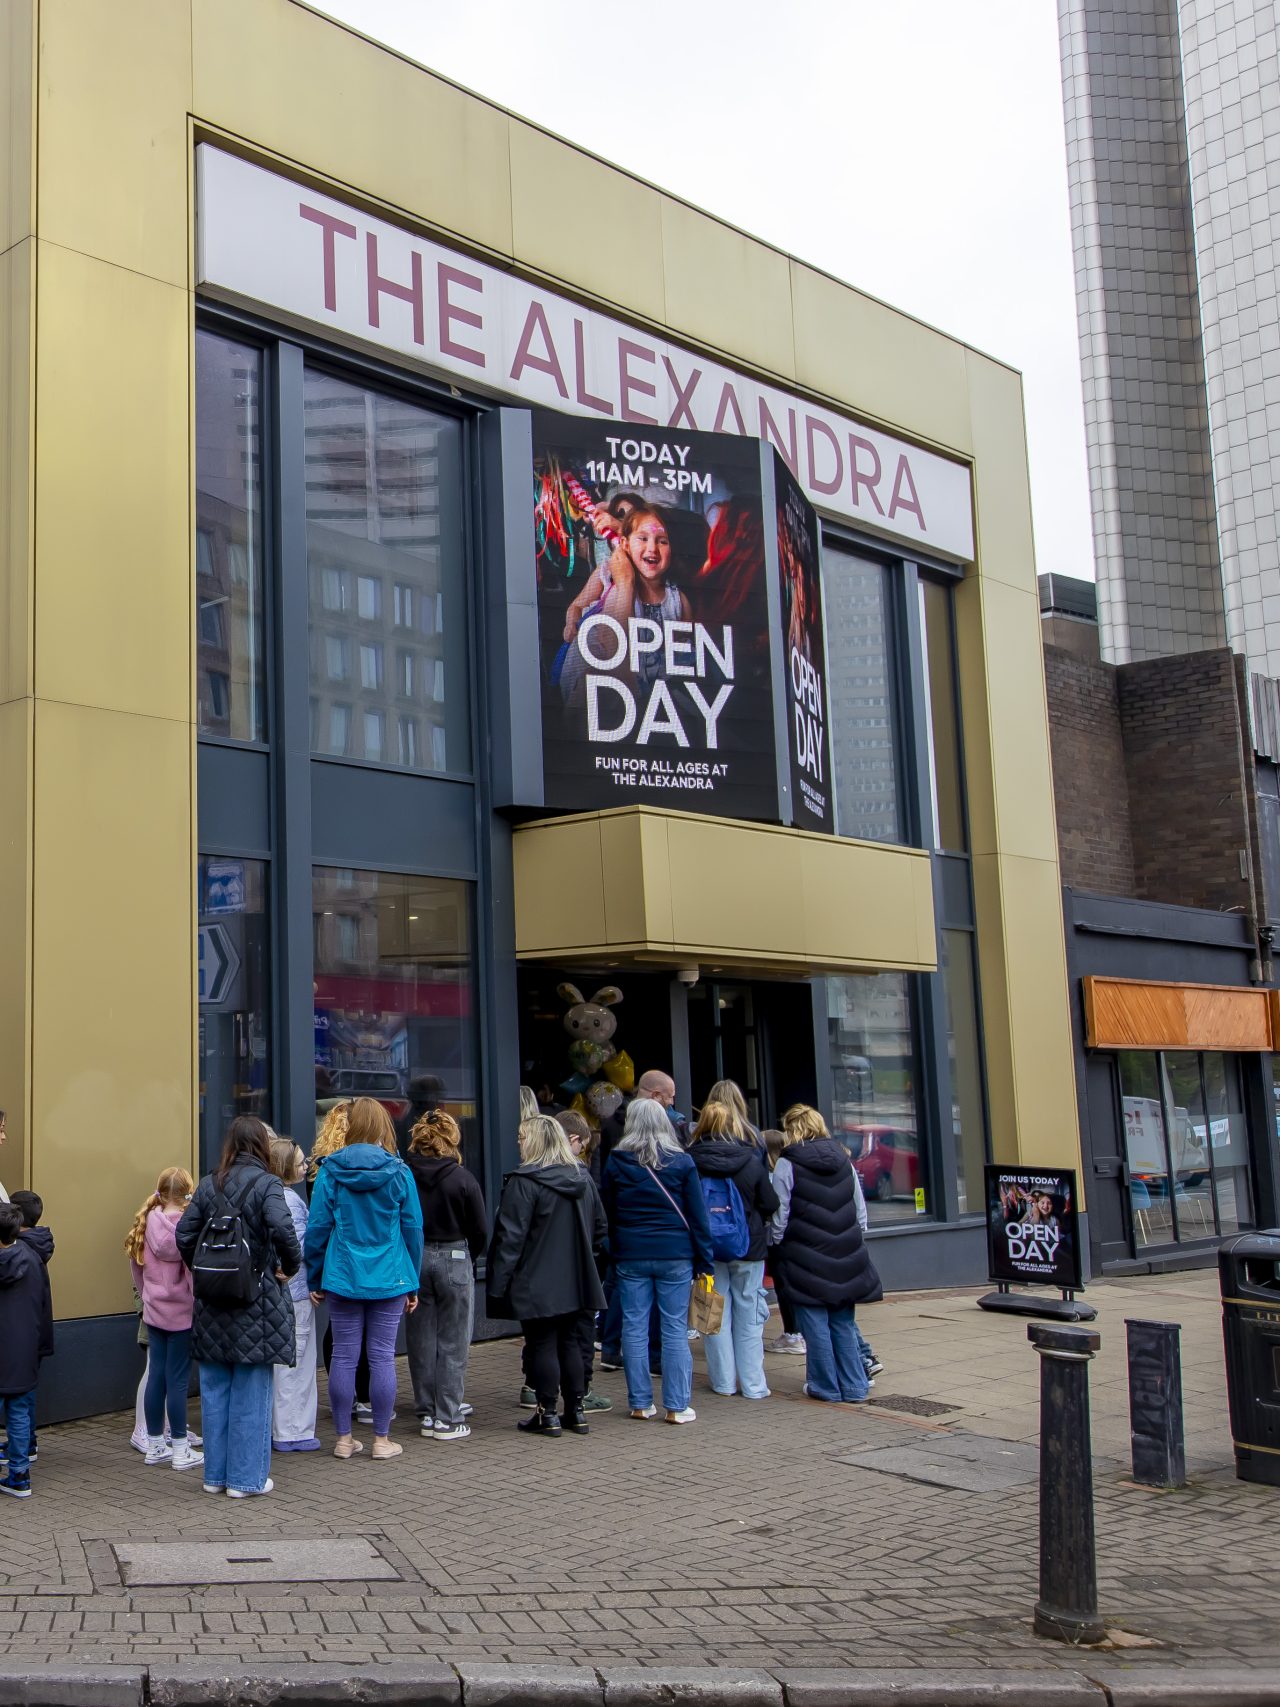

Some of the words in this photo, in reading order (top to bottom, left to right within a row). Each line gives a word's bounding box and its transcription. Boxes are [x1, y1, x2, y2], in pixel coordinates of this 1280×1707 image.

[299, 202, 486, 369] THE
[509, 300, 927, 532] ALEXANDRA
[605, 436, 691, 467] TODAY
[586, 460, 645, 487] 11AM
[649, 476, 659, 484] -
[662, 468, 713, 495] 3PM
[577, 613, 735, 680] OPEN
[791, 646, 823, 722] OPEN
[585, 673, 735, 750] DAY
[794, 701, 823, 783] DAY
[595, 756, 620, 770] FUN
[622, 758, 648, 772] FOR
[650, 760, 674, 774] ALL
[676, 761, 710, 775] AGES
[711, 763, 728, 776] AT
[611, 771, 637, 786] THE
[638, 774, 714, 790] ALEXANDRA
[999, 1174, 1016, 1183] JOIN
[1017, 1175, 1029, 1184] US
[1029, 1176, 1060, 1186] TODAY
[1005, 1222, 1060, 1243] OPEN
[1008, 1238, 1060, 1262] DAY
